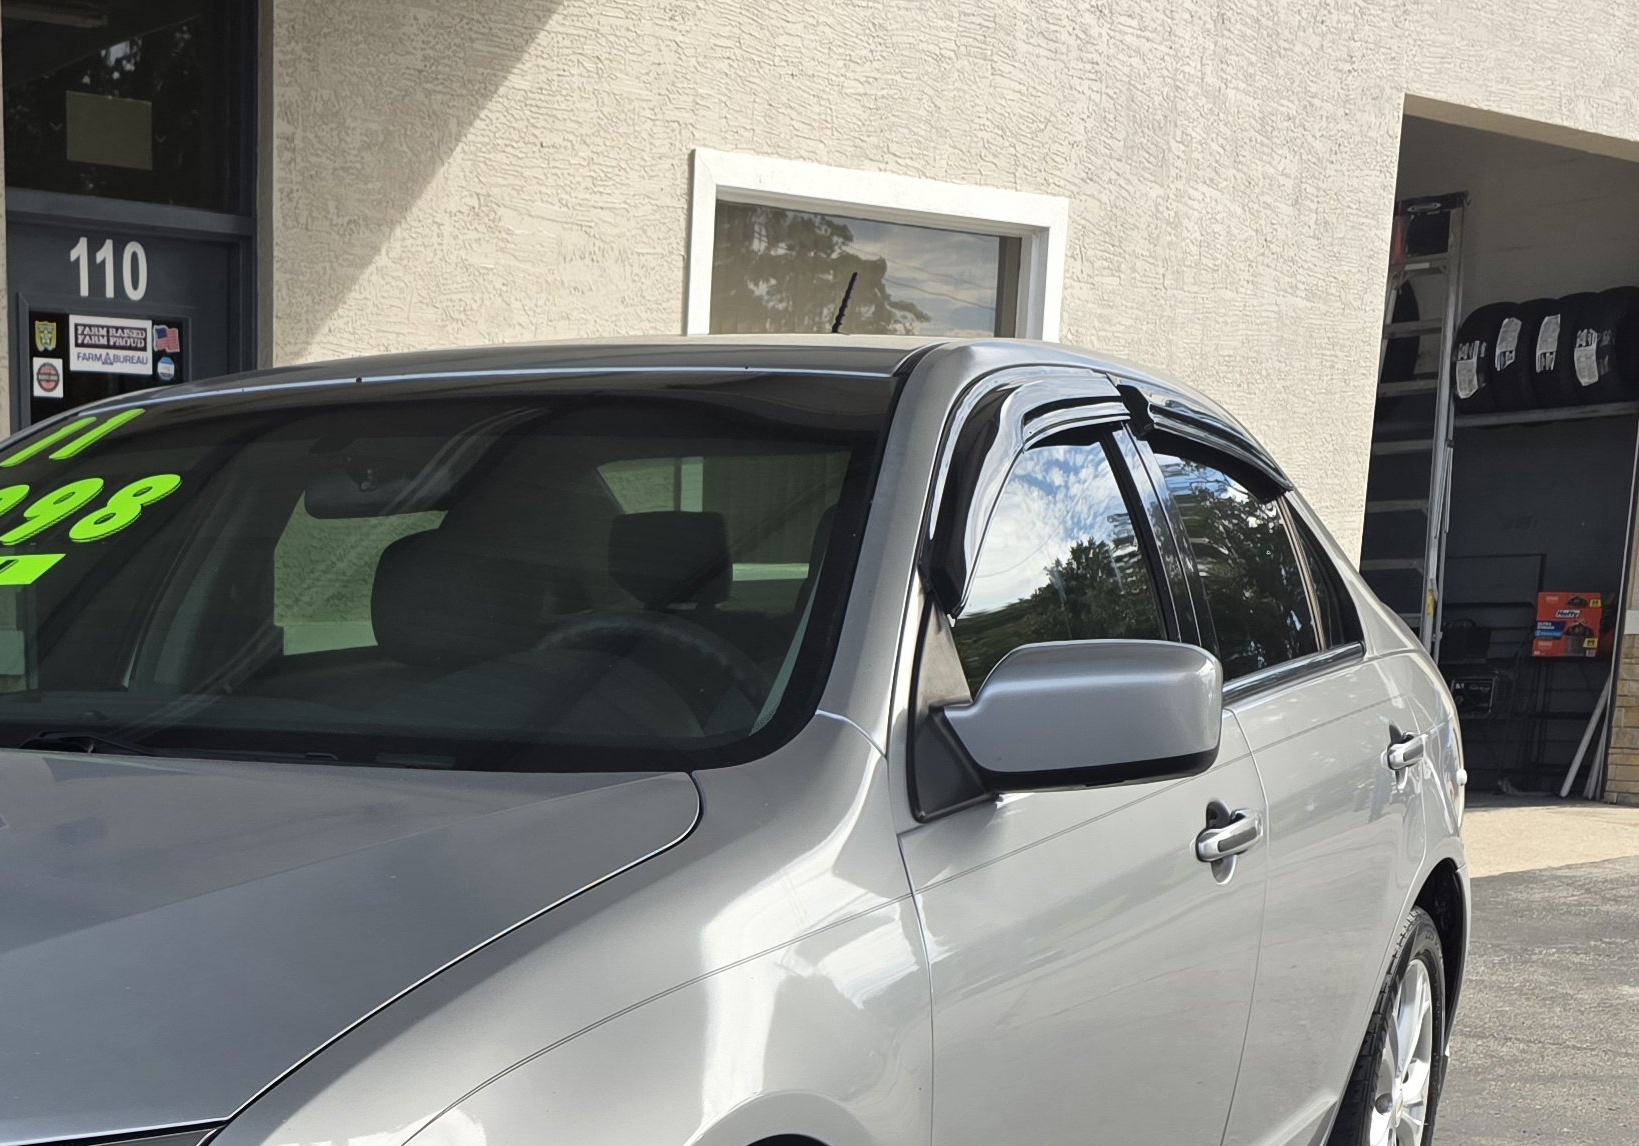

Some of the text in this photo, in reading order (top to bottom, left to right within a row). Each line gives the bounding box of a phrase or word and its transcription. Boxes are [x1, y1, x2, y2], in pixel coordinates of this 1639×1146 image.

[69, 236, 148, 301] 110
[77, 325, 146, 339] FARM RAISED
[77, 335, 145, 349] FARM PROUD
[77, 352, 148, 366] FARM BUREAU
